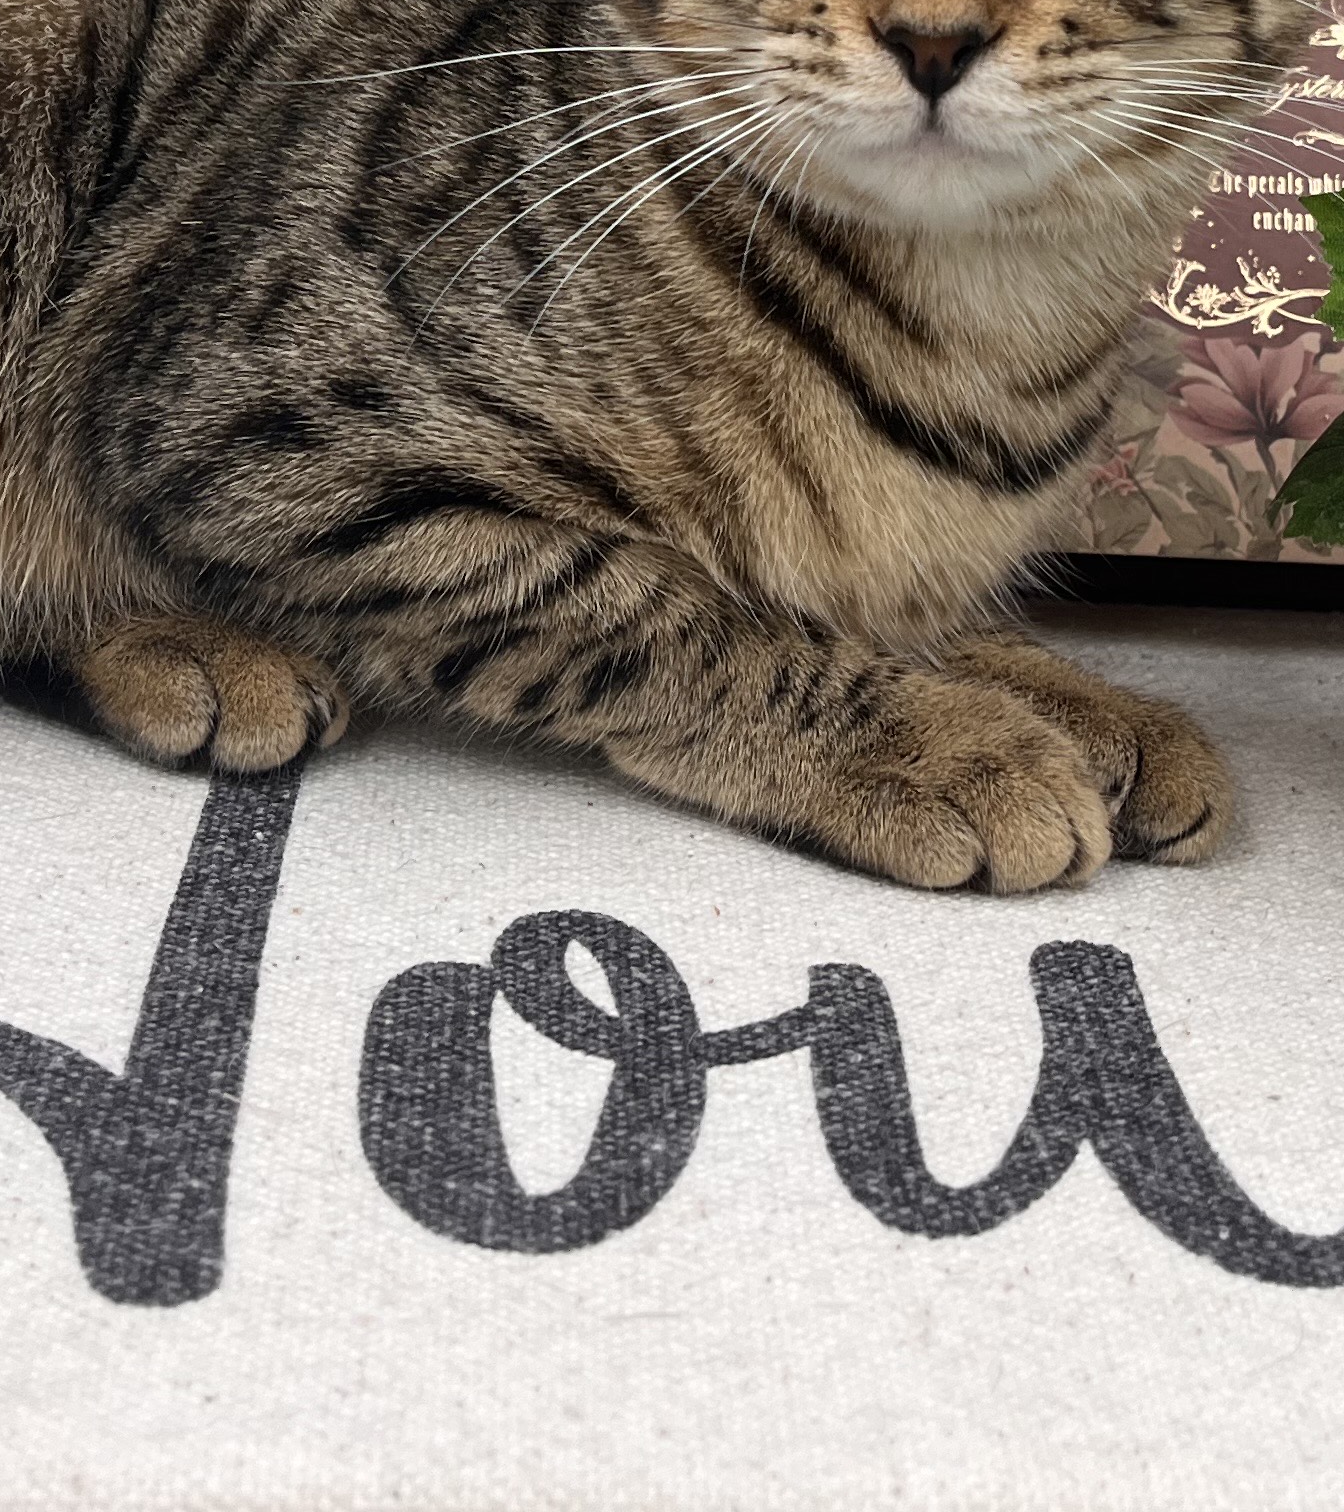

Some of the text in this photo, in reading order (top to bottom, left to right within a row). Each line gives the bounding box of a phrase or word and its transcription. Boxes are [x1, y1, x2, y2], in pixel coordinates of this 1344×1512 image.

[1209, 168, 1243, 195] The
[1248, 171, 1304, 198] petals
[1253, 207, 1317, 234] enchan
